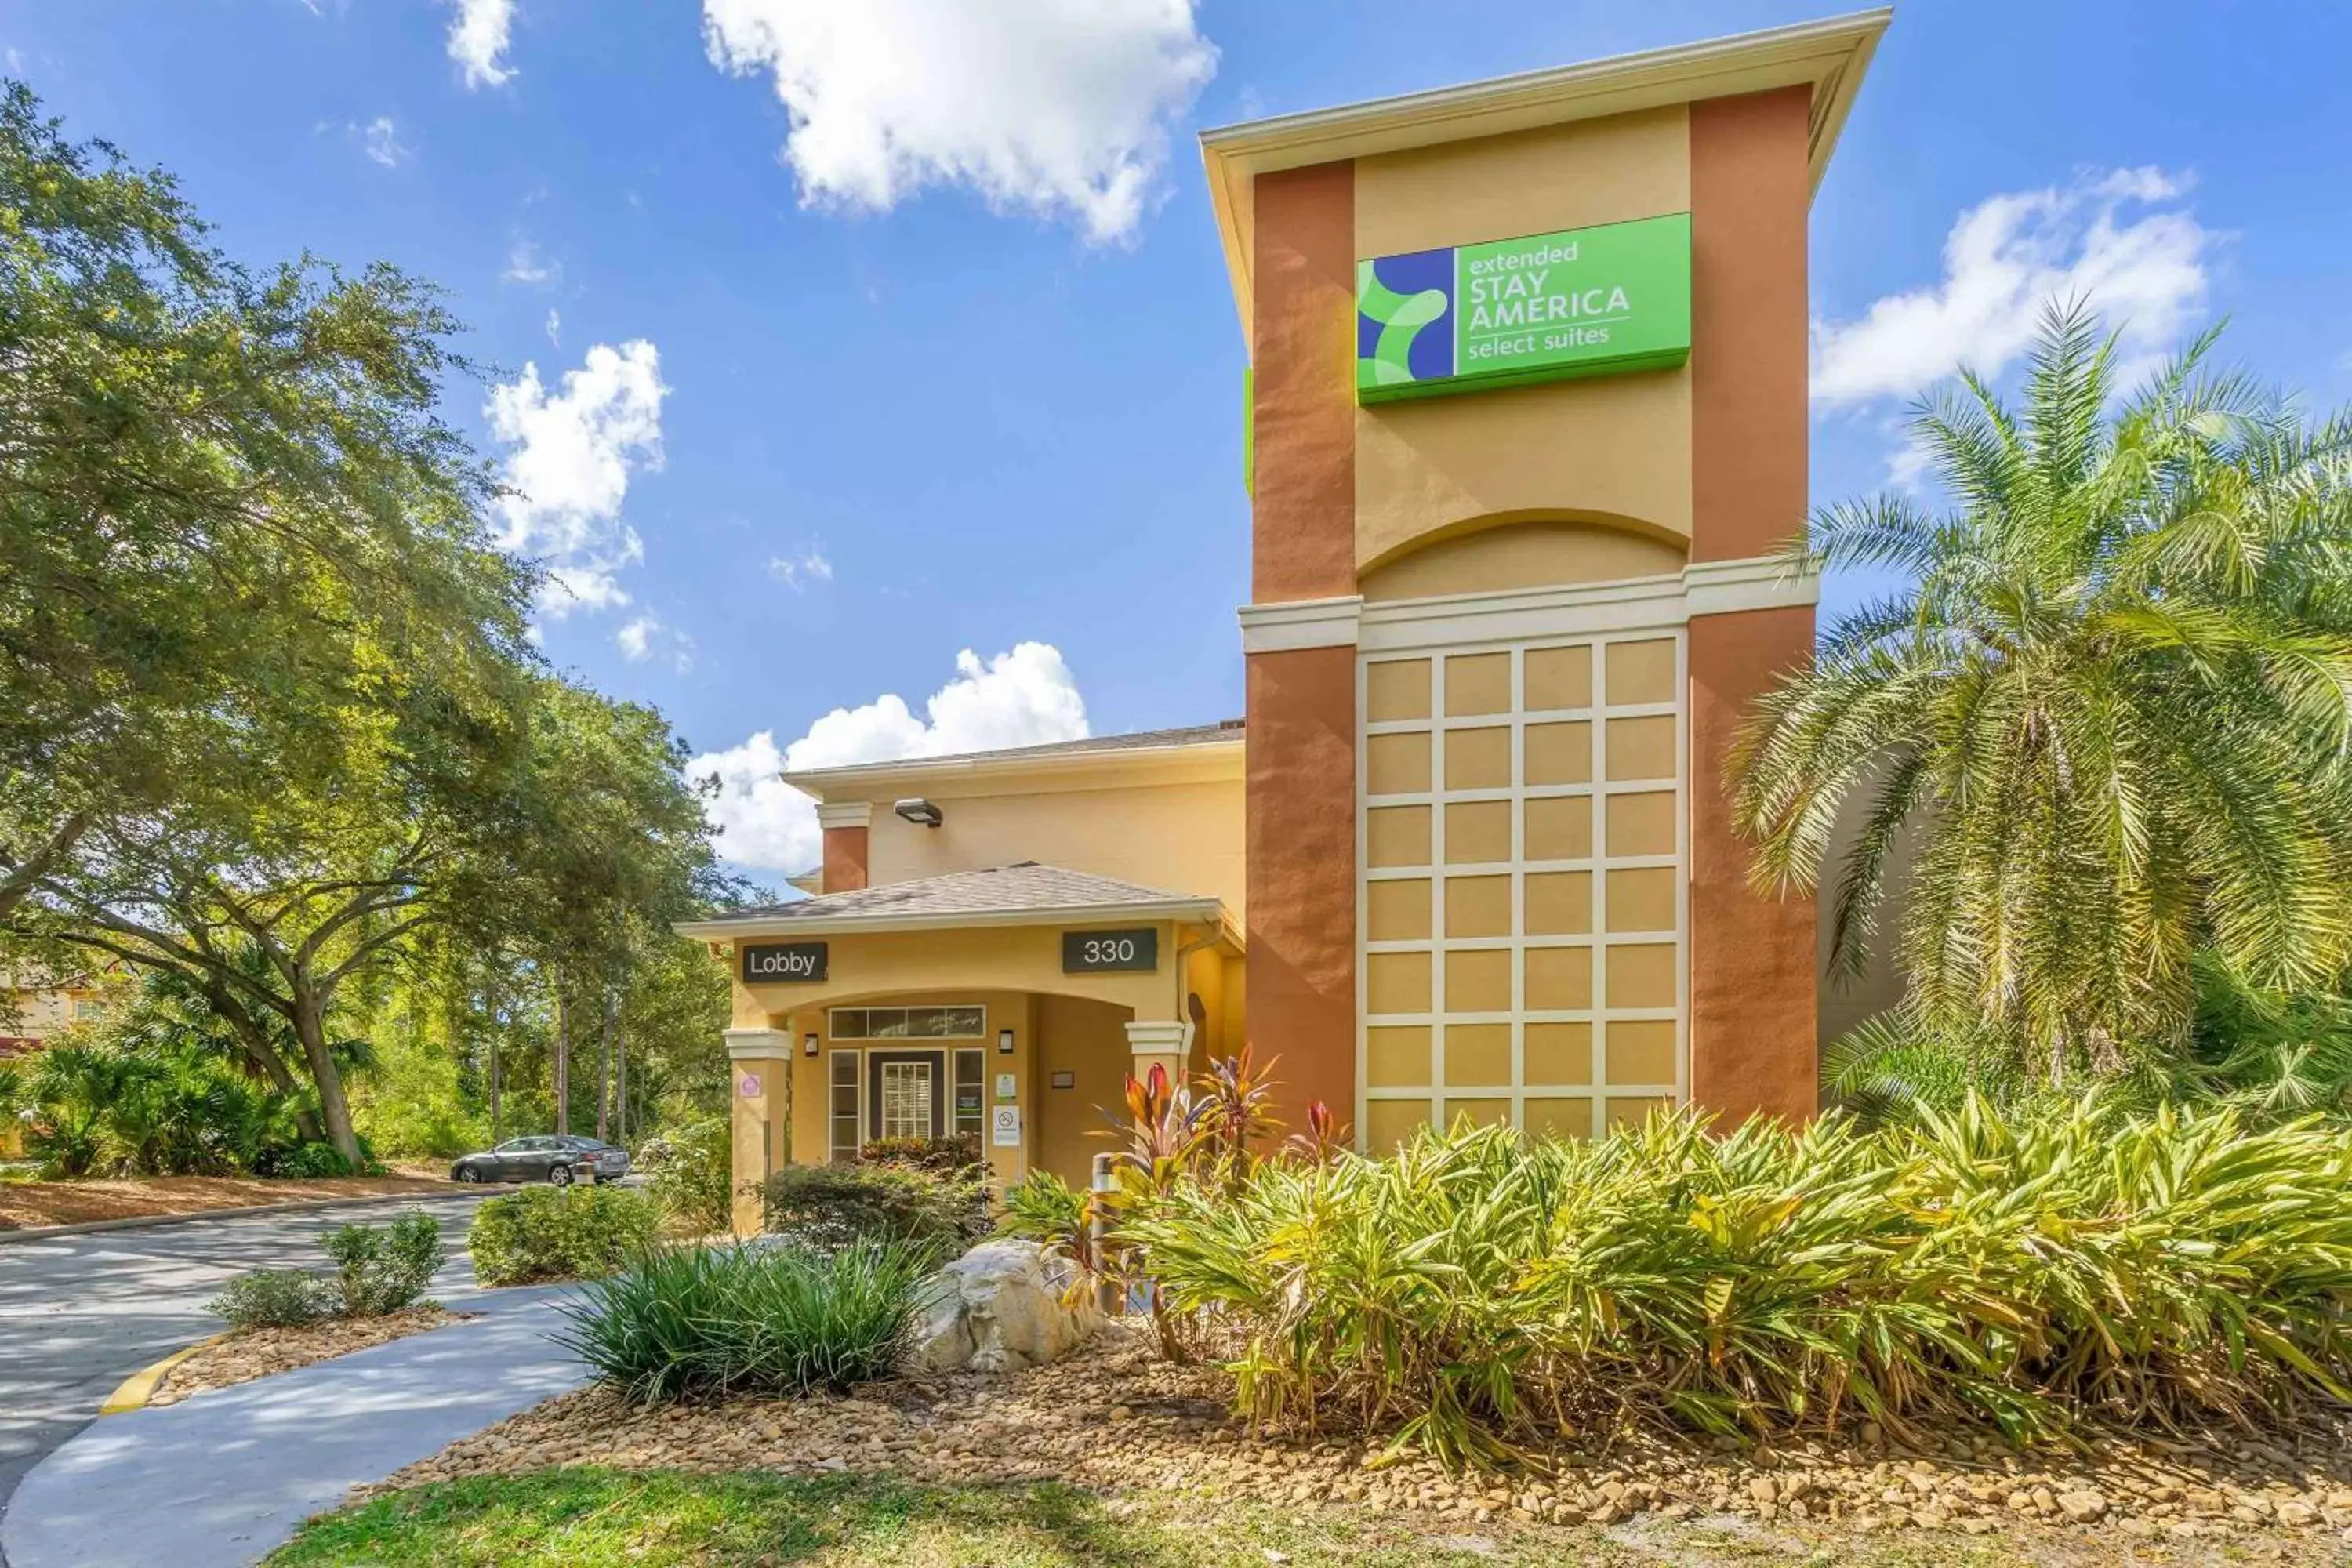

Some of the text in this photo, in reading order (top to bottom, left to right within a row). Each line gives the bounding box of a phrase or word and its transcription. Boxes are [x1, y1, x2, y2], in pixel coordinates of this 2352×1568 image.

[1469, 241, 1578, 274] extended
[1470, 268, 1550, 303] STAY
[1468, 286, 1630, 331] AMERICA
[1468, 327, 1610, 360] select suites
[750, 950, 815, 976] Lobby
[1084, 939, 1134, 964] 330
